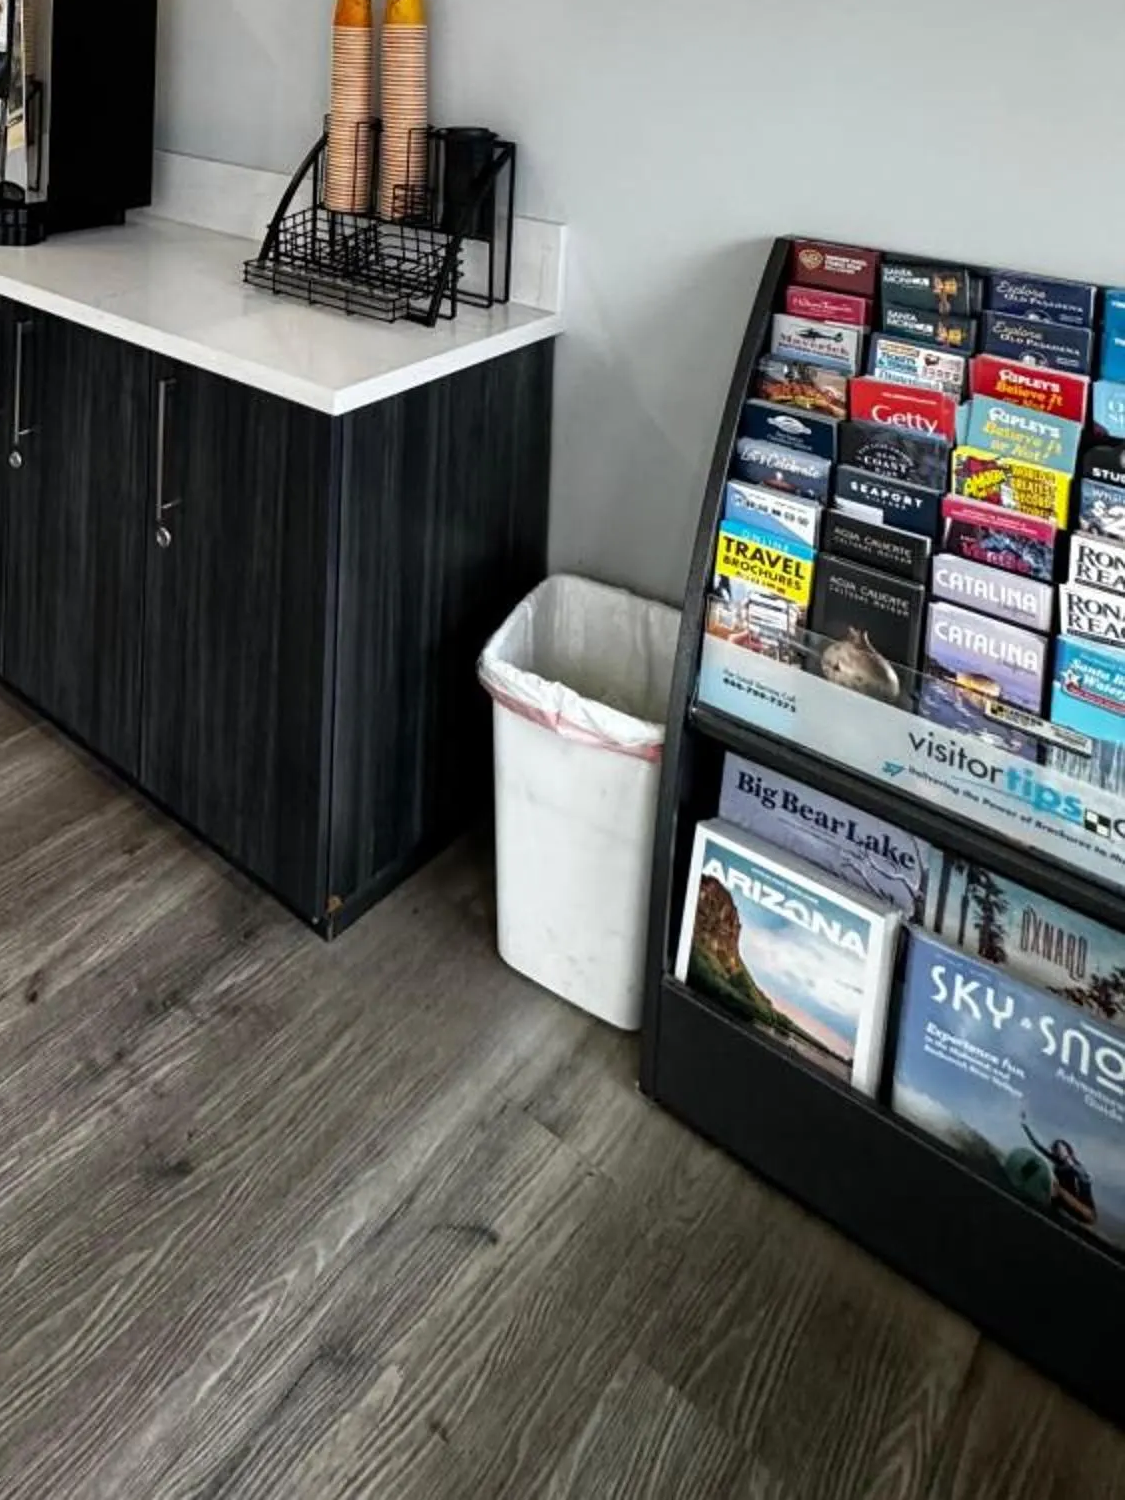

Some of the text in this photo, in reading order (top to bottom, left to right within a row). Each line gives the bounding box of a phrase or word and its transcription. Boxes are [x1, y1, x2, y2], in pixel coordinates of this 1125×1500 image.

[994, 280, 1047, 299] Explore
[991, 320, 1043, 341] Explore
[871, 404, 939, 438] Getty
[722, 534, 806, 580] TRAVEL
[722, 554, 802, 591] BROCHURES
[935, 568, 1037, 615] CATALINA
[934, 620, 1038, 672] CATALINA
[908, 731, 1084, 825] visitortips
[737, 770, 778, 811] Big
[780, 788, 845, 838] Bear
[845, 818, 917, 872] Lake
[961, 787, 981, 803] the
[981, 797, 1018, 818] Power
[1019, 813, 1034, 824] of
[702, 858, 870, 961] ARIZONA
[1019, 904, 1089, 982] OXNARD
[930, 964, 1016, 1031] SKY
[925, 1020, 1000, 1066] Experience
